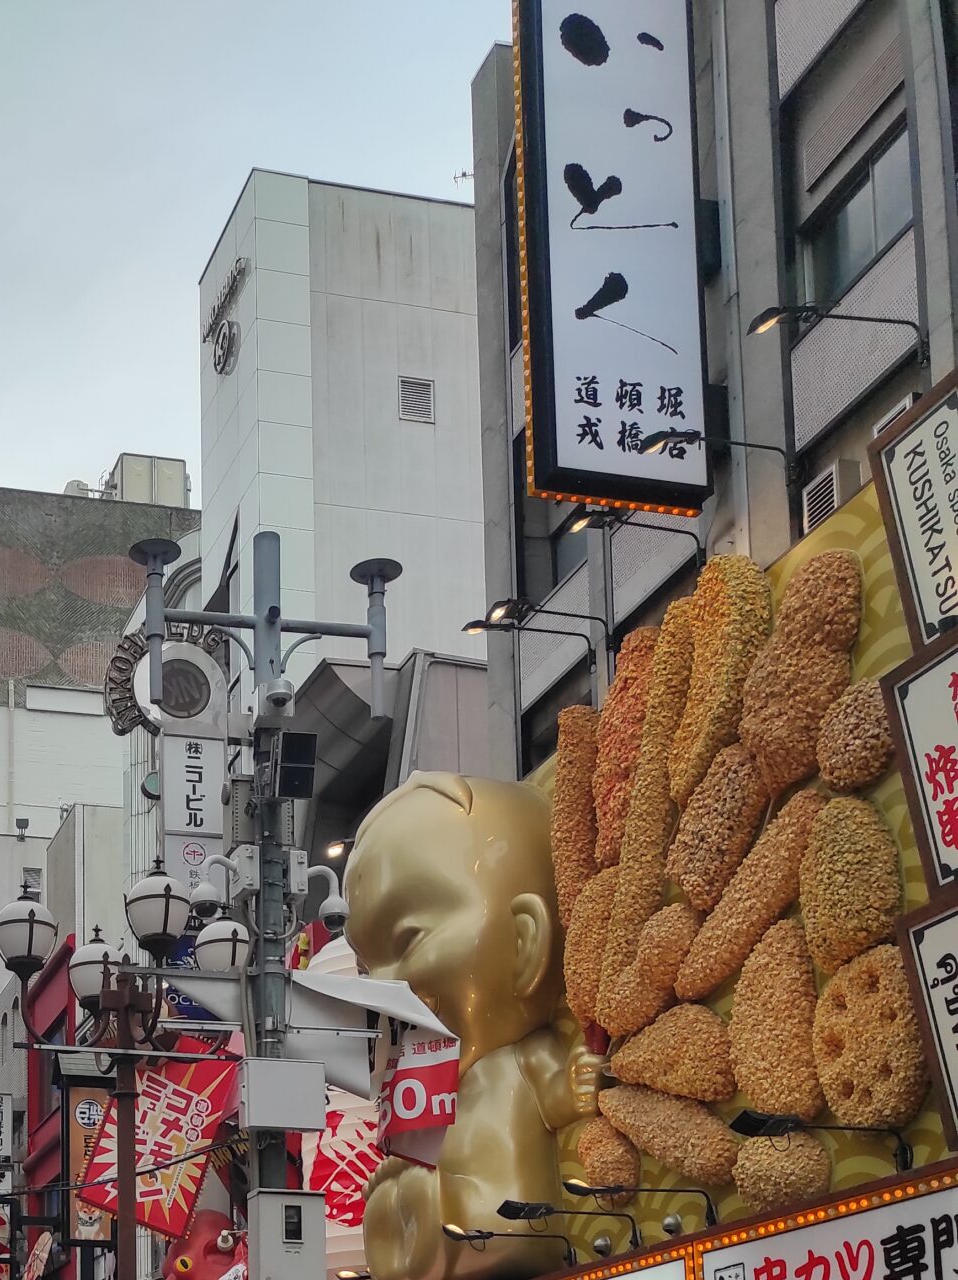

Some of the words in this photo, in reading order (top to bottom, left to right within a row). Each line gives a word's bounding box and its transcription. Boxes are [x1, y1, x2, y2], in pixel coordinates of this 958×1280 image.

[574, 375, 686, 420] 道頓堀
[933, 419, 957, 486] Osaka
[903, 438, 958, 616] KUSHIKATSU
